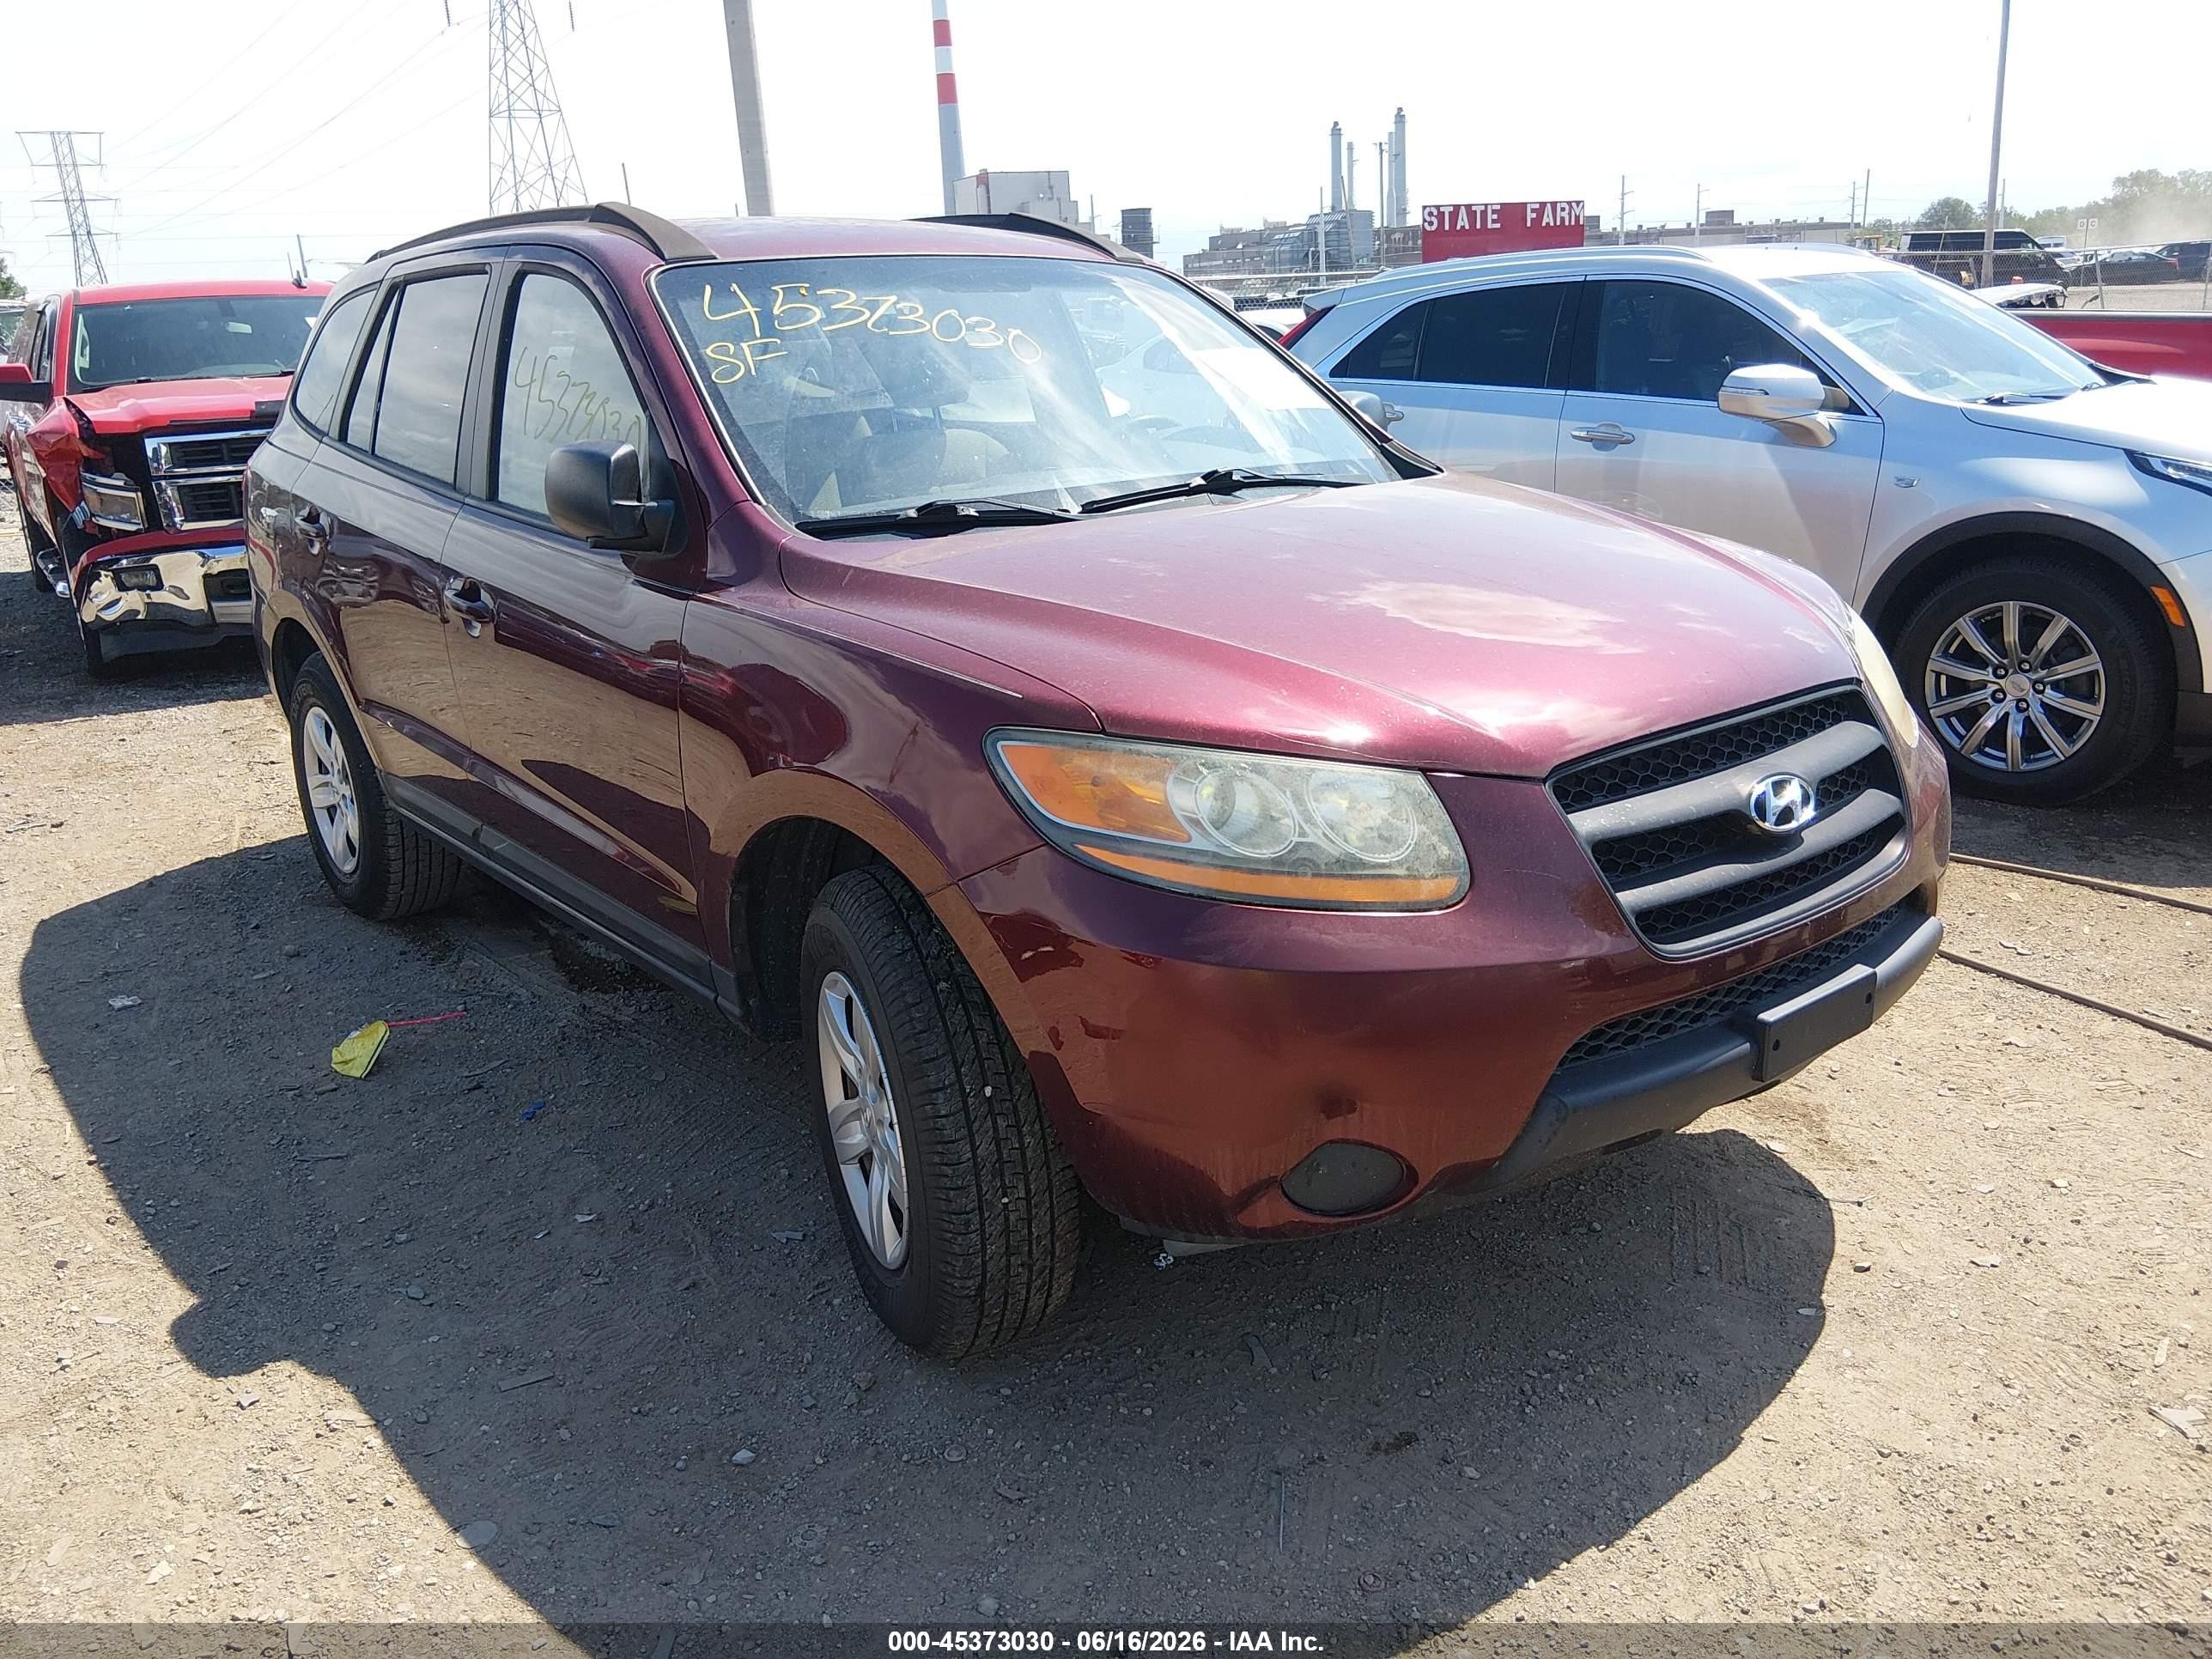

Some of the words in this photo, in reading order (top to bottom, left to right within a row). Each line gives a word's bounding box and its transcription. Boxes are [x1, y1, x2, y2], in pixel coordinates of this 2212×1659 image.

[1422, 204, 1501, 232] STATE
[1526, 201, 1584, 228] FARM
[704, 283, 1042, 364] 45373030
[706, 337, 788, 384] SF
